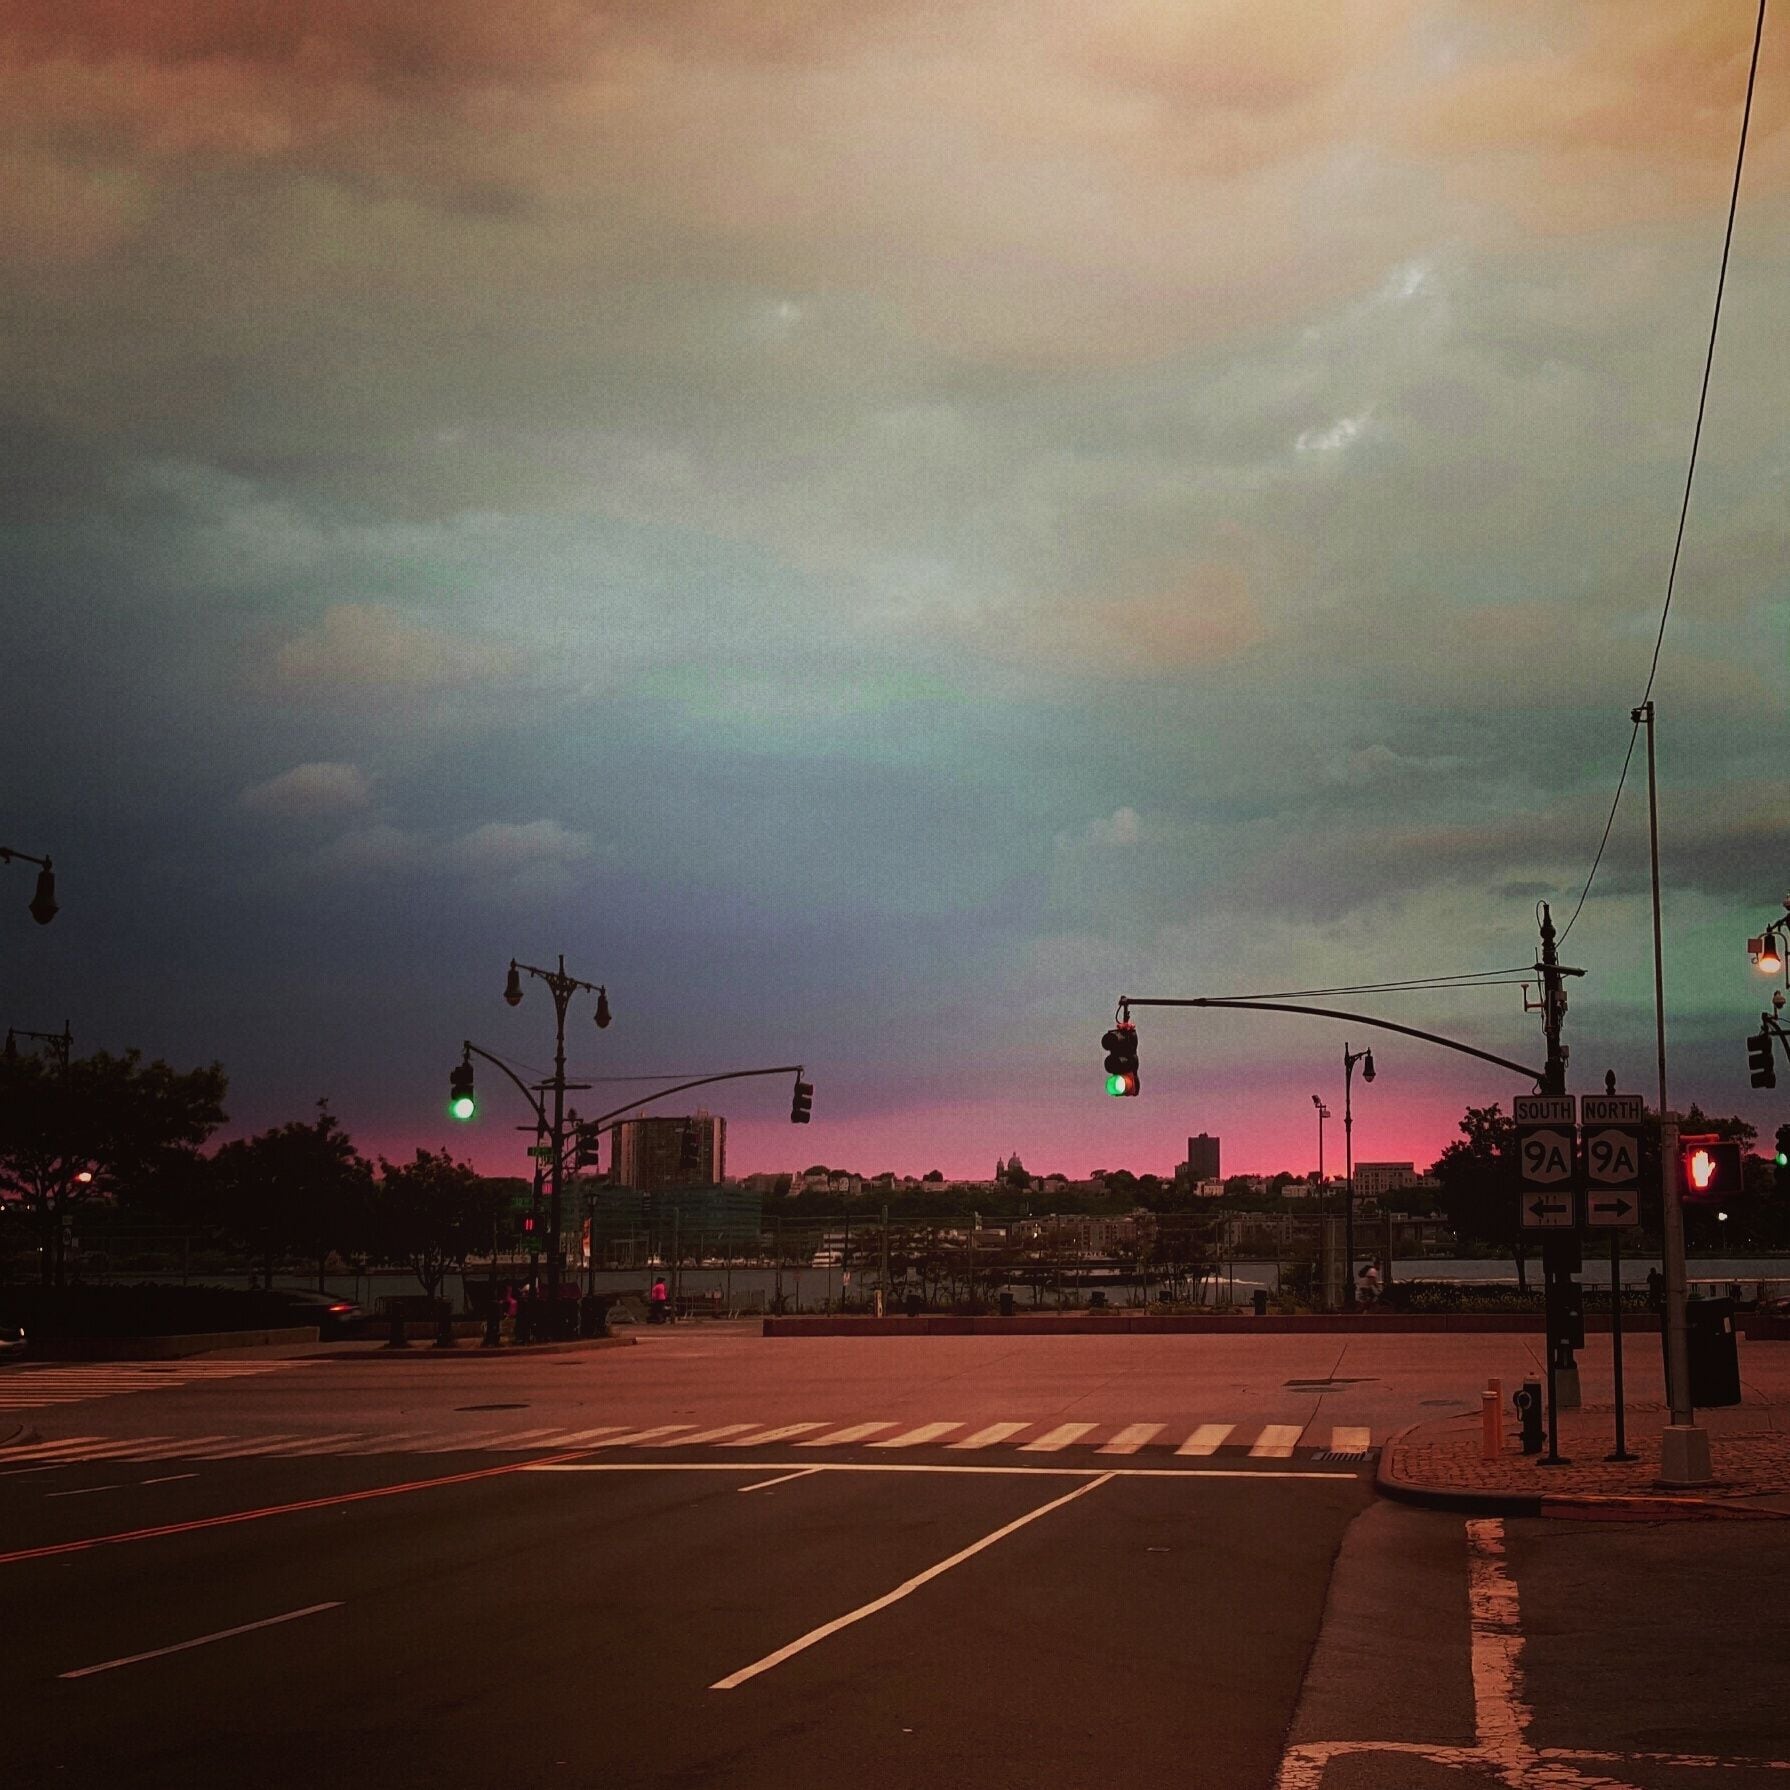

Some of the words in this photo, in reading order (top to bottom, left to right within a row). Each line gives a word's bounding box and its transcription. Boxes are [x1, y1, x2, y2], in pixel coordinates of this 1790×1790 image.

[1518, 1102, 1571, 1119] SOUTH
[1585, 1102, 1639, 1119] NORTH
[1524, 1141, 1567, 1173] 9A
[1591, 1141, 1634, 1173] 9A
